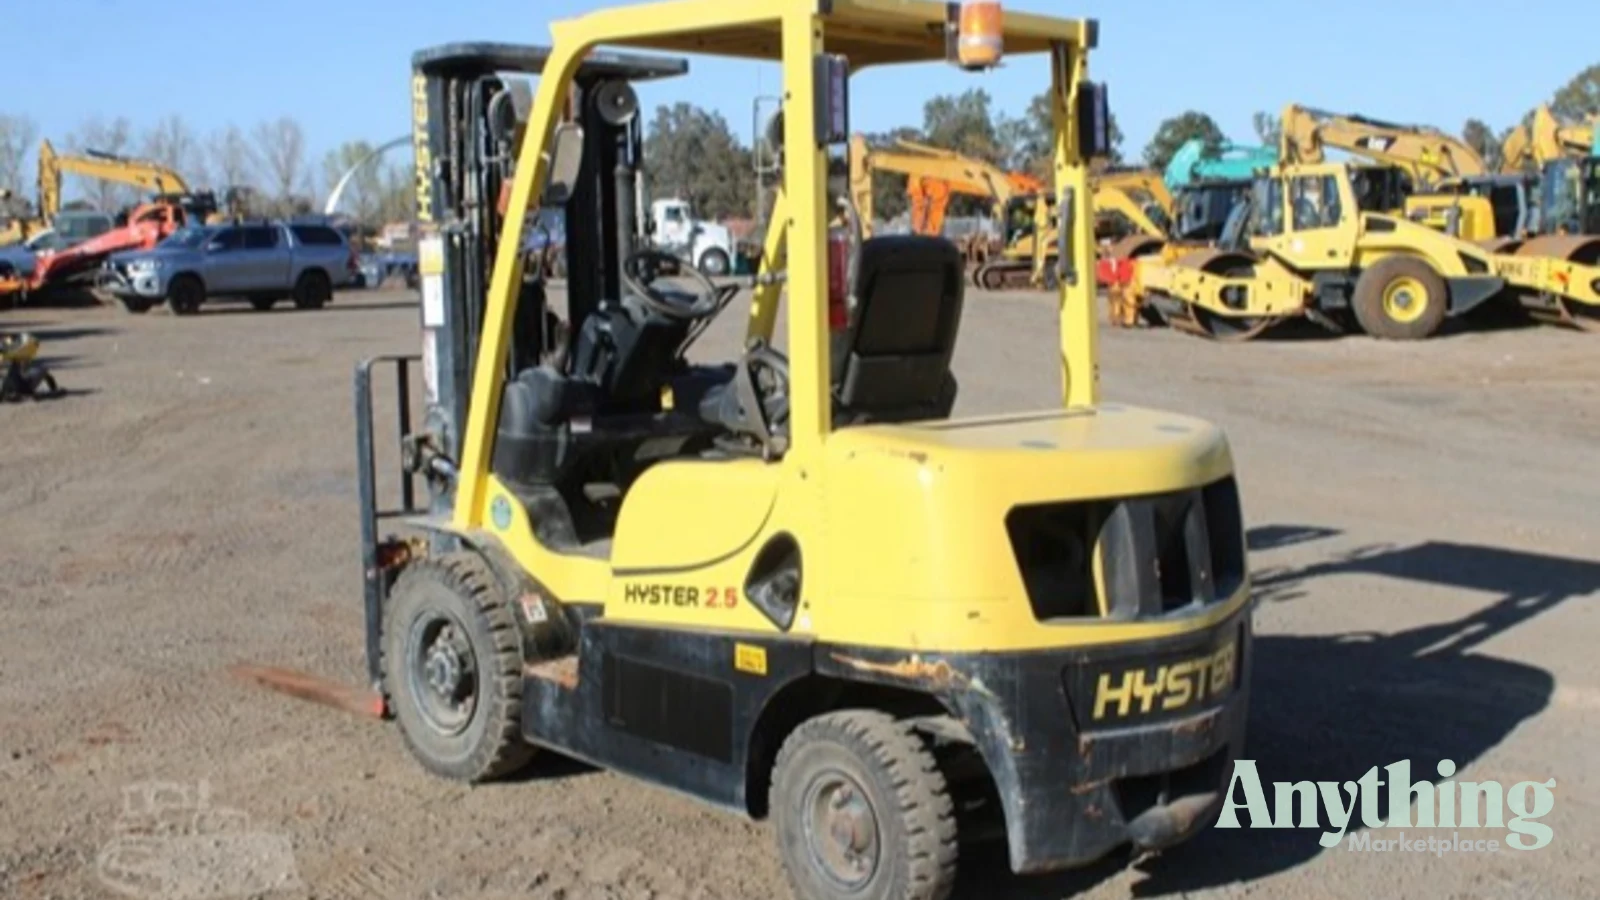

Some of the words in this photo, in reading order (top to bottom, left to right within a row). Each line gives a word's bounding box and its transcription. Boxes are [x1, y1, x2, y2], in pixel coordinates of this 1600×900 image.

[413, 74, 432, 221] HYSTER
[624, 583, 699, 608] HYSTER
[704, 586, 738, 609] 2.5
[1092, 641, 1237, 720] HYSTER
